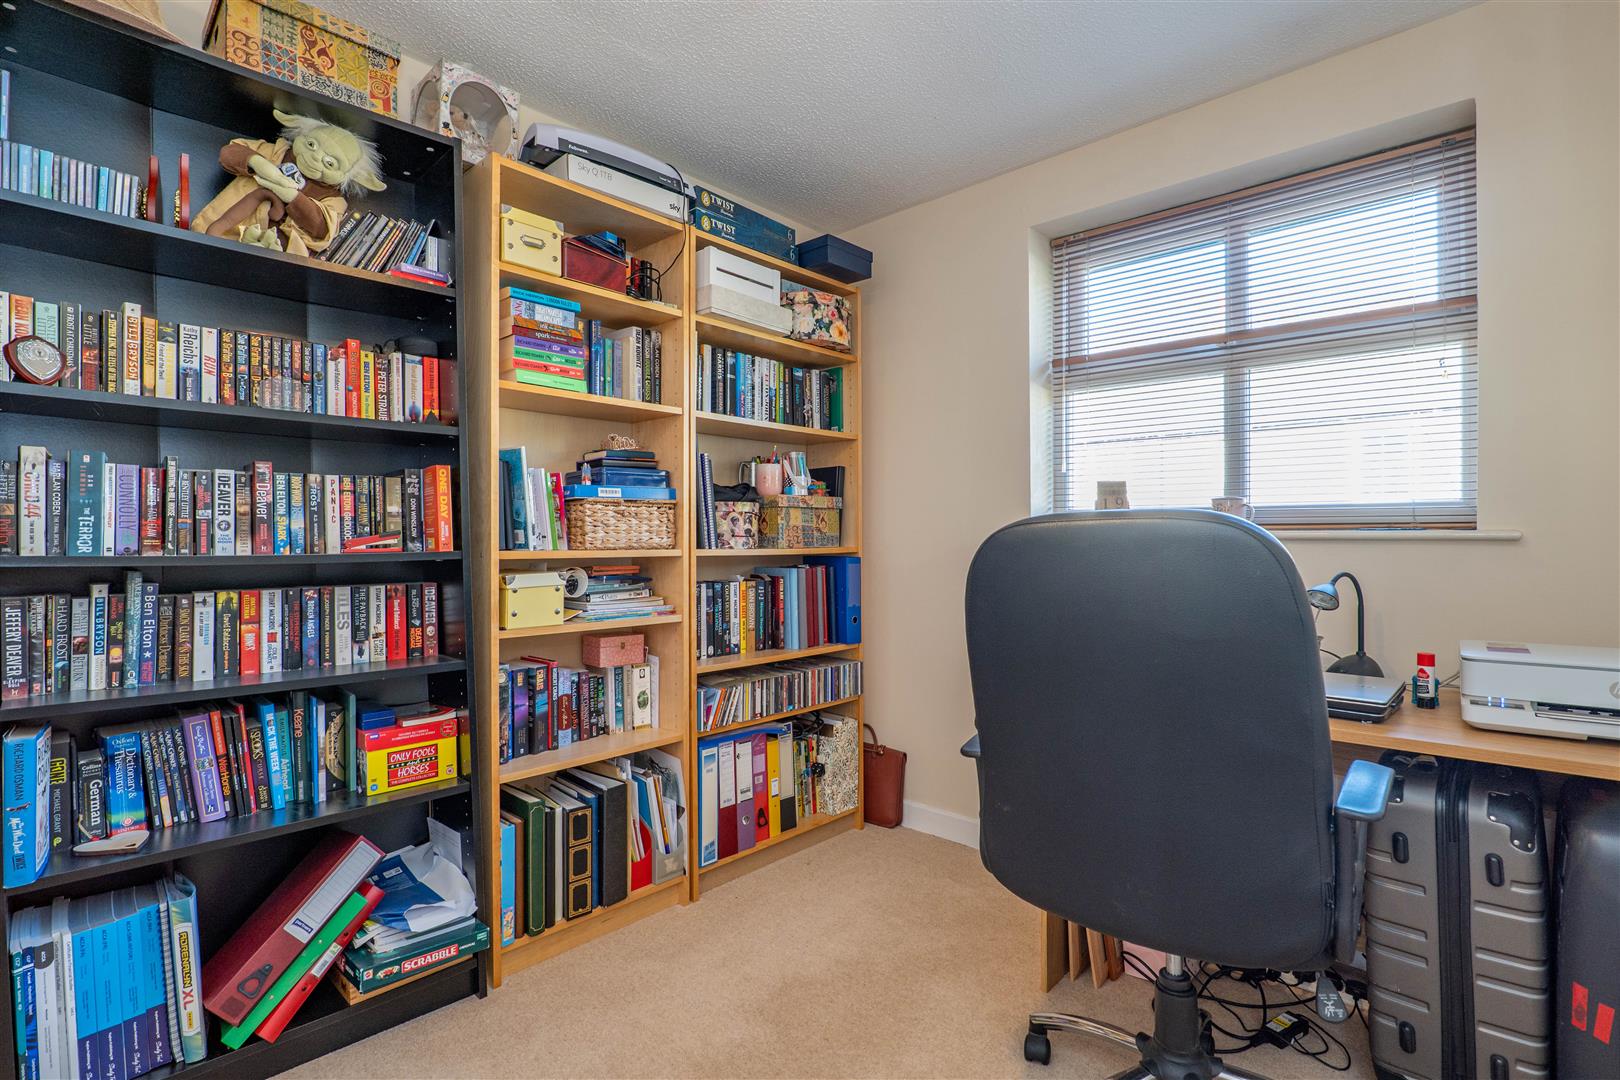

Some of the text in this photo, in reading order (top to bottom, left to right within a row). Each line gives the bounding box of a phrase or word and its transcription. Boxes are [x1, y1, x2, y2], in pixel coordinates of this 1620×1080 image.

[710, 194, 735, 212] TWIST
[710, 218, 736, 235] TWIST
[67, 313, 75, 329] FROST
[84, 324, 93, 345] LITTLE
[127, 317, 140, 380] BILL BRYSON
[145, 328, 156, 366] GRISHAM
[182, 334, 198, 365] Reichs
[204, 355, 217, 377] RUN
[378, 371, 387, 392] PETER
[53, 462, 61, 515] HARLAN COBEN
[119, 475, 137, 530] CONNOLLY
[217, 475, 231, 516] DEAVER
[256, 483, 270, 519] Deaver
[440, 469, 449, 519] ONE DAY
[276, 474, 287, 541] BEN ELTON STARK
[343, 477, 352, 541] BEN ELTON GRIDLOC
[77, 515, 95, 554] TERROR
[96, 599, 104, 618] BILL
[144, 595, 155, 616] Ben
[181, 608, 190, 624] SIMON
[223, 613, 232, 628] David
[425, 589, 436, 624] DEAVER
[5, 607, 22, 676] JEFFERY DEAVER
[57, 605, 68, 661] HARD FROST
[95, 620, 104, 655] BRYSON
[143, 620, 155, 648] Elton
[158, 615, 173, 674] Darkness Demands
[180, 626, 190, 642] CLARK
[222, 628, 231, 651] Baldacci
[73, 656, 86, 681] RETURN
[536, 670, 544, 690] CRAIS
[294, 708, 304, 737] Keane
[268, 736, 278, 750] THE
[391, 746, 436, 763] ONLY FOOLS
[14, 744, 24, 800] RICHARD OSMAN
[114, 748, 126, 794] Thesaurus
[124, 747, 137, 791] Dictionary
[271, 750, 281, 772] WEEK
[280, 759, 291, 790] Airhead
[397, 763, 430, 777] HORSES
[89, 780, 103, 826] German
[179, 931, 192, 988] ADRENALYN
[403, 946, 457, 971] SCRABBLE
[182, 988, 194, 1010] XL
